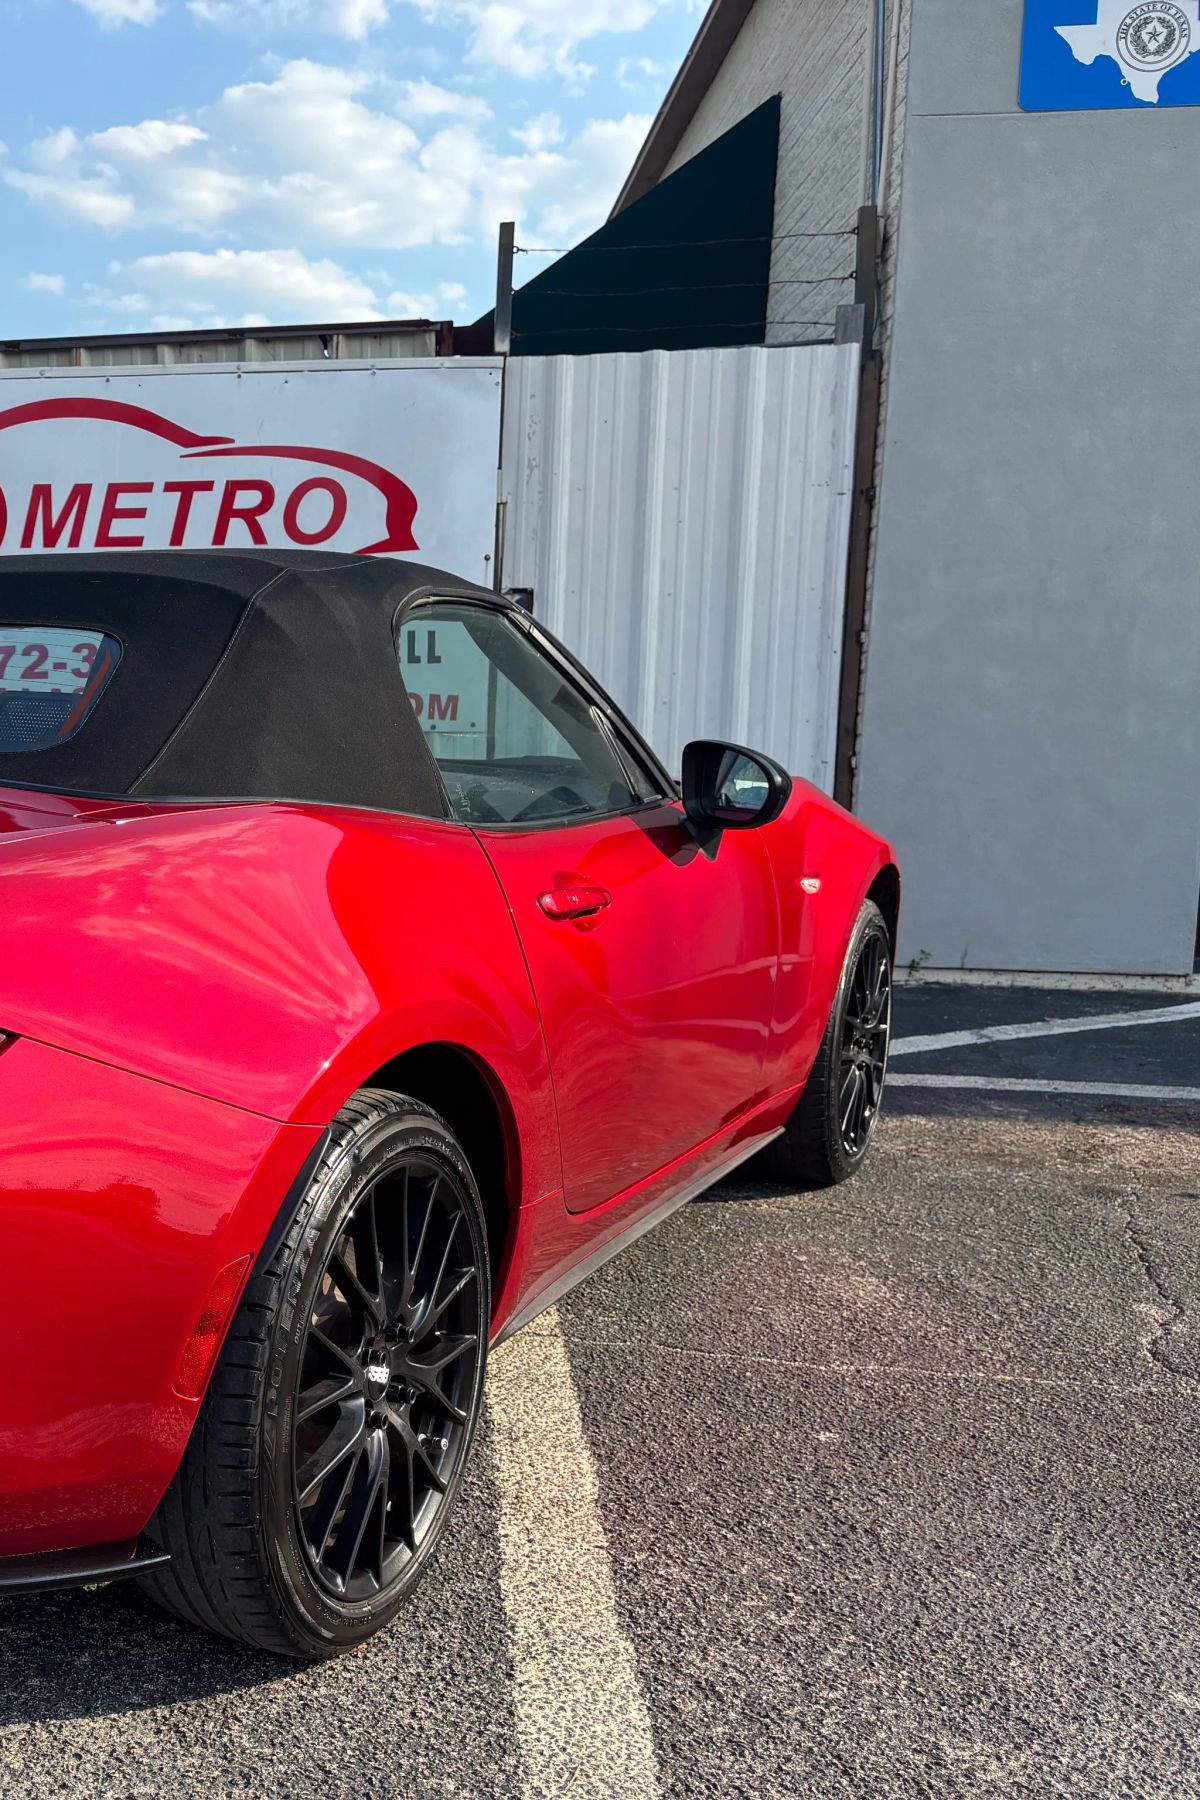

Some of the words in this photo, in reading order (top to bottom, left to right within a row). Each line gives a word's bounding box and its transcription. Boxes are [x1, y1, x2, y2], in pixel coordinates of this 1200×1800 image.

[1119, 21, 1130, 41] THE
[1129, 4, 1158, 19] STATE
[1161, 4, 1173, 12] OF
[1173, 10, 1188, 38] TEXAS
[19, 477, 348, 548] METRO
